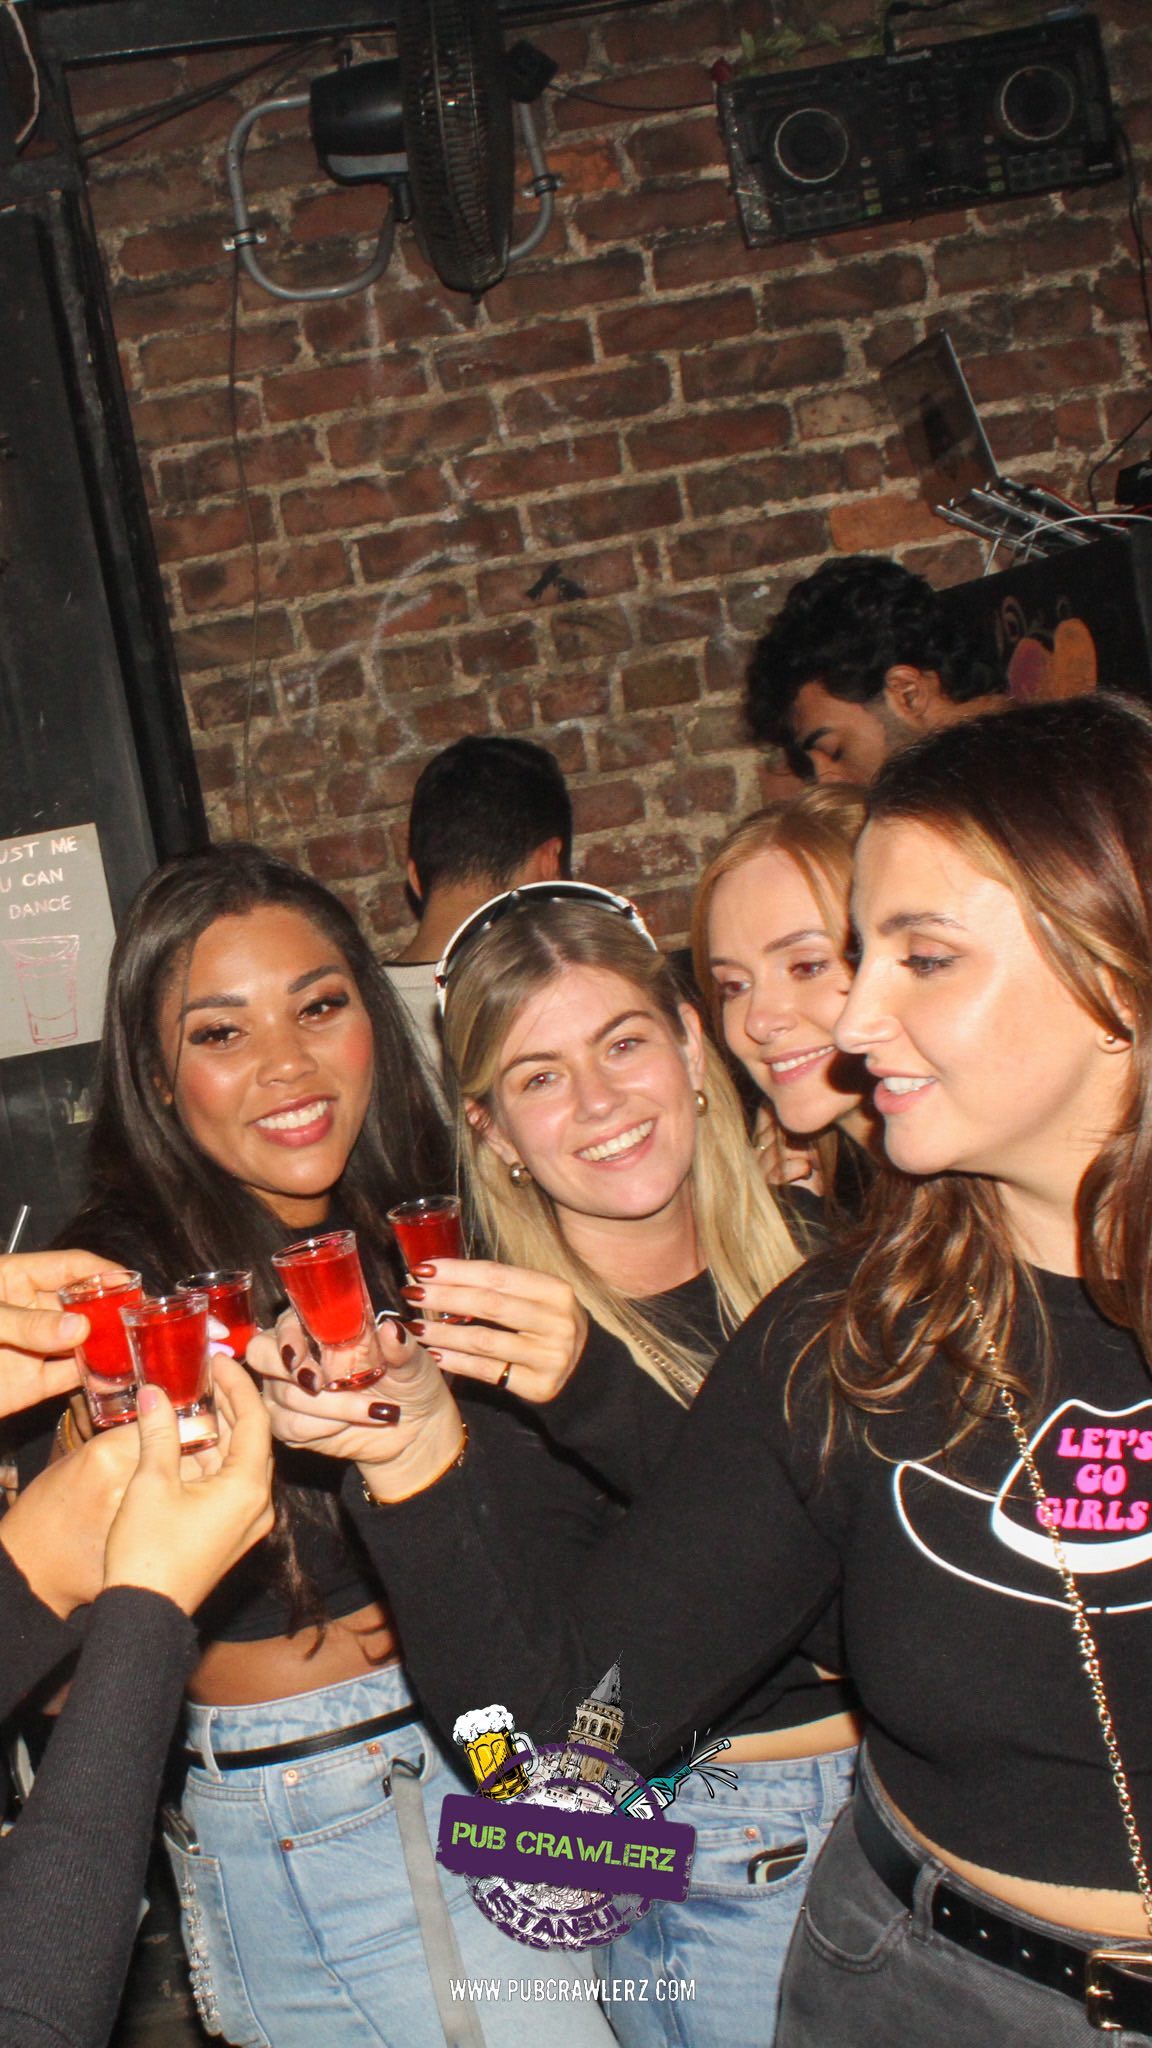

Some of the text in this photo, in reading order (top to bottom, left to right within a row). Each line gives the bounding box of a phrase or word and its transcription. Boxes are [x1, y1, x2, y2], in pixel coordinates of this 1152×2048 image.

[50, 835, 79, 855] ME
[22, 867, 64, 887] CAN
[9, 894, 72, 920] DANCE
[1057, 1427, 1152, 1461] LET'S
[1076, 1463, 1127, 1495] GO
[1036, 1497, 1150, 1531] GIRLS
